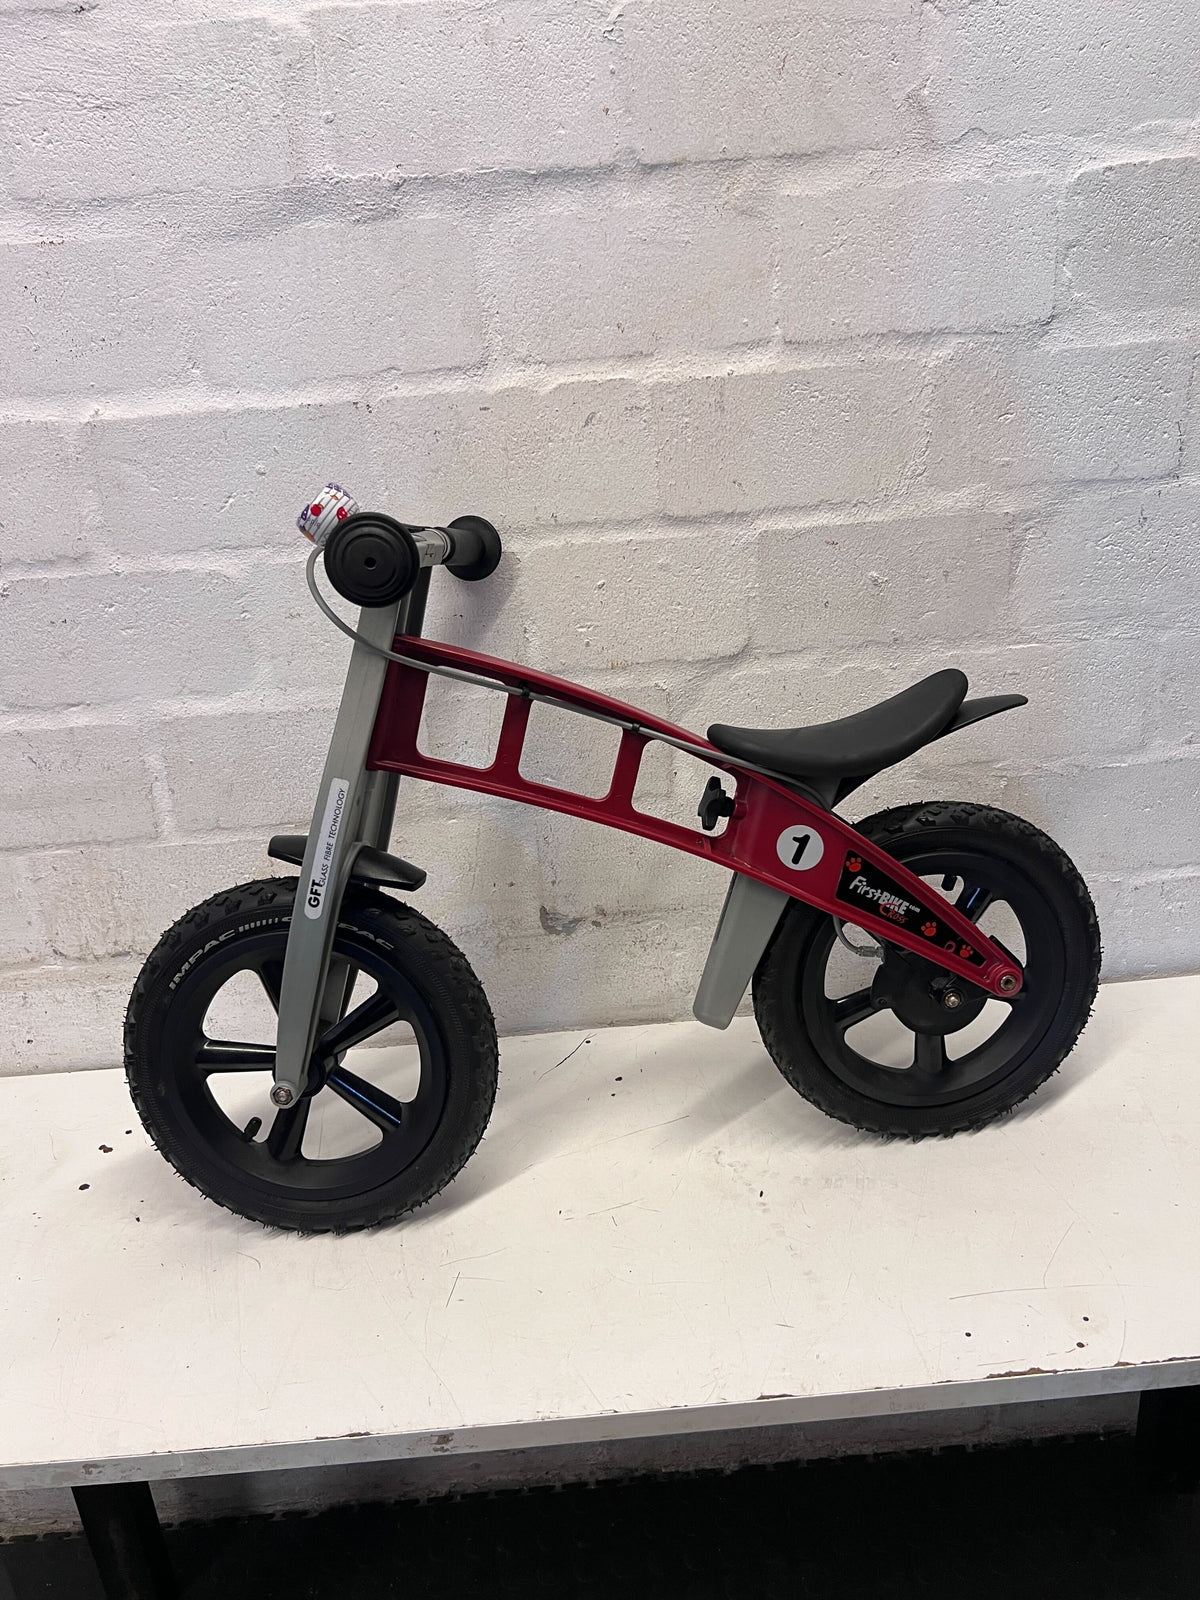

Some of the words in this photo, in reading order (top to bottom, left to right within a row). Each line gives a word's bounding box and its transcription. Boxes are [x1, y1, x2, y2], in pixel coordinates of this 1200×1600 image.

[328, 788, 346, 840] TECHNOLOGY
[324, 842, 334, 861] FIBRE
[792, 834, 811, 865] 1
[319, 864, 329, 886] GLASS
[308, 879, 323, 908] GFT
[169, 929, 235, 990] IMPAC
